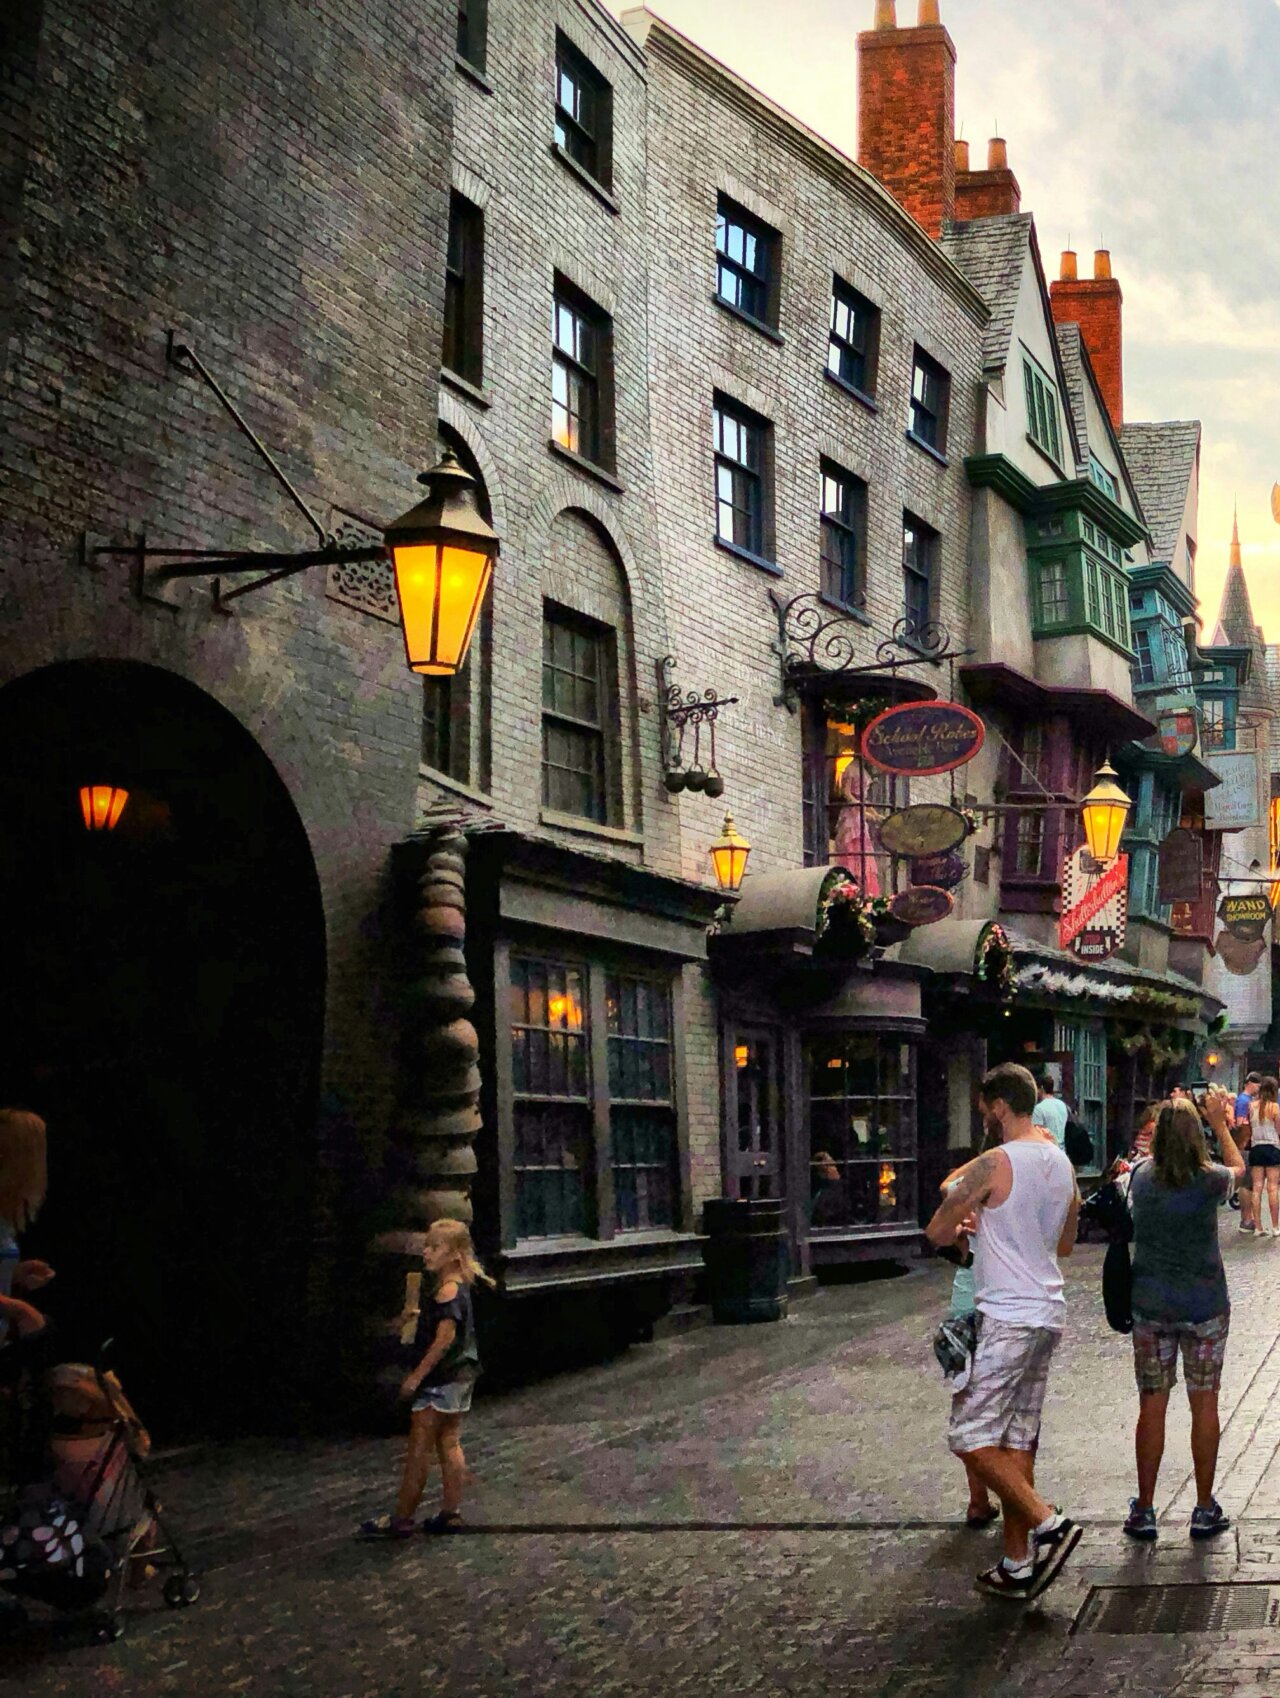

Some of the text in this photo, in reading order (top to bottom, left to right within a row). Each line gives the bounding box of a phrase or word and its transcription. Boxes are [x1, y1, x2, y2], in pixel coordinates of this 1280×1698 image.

[1227, 900, 1266, 913] WAND
[1226, 910, 1266, 922] SHOWROOM
[1081, 944, 1105, 955] INSIDE
